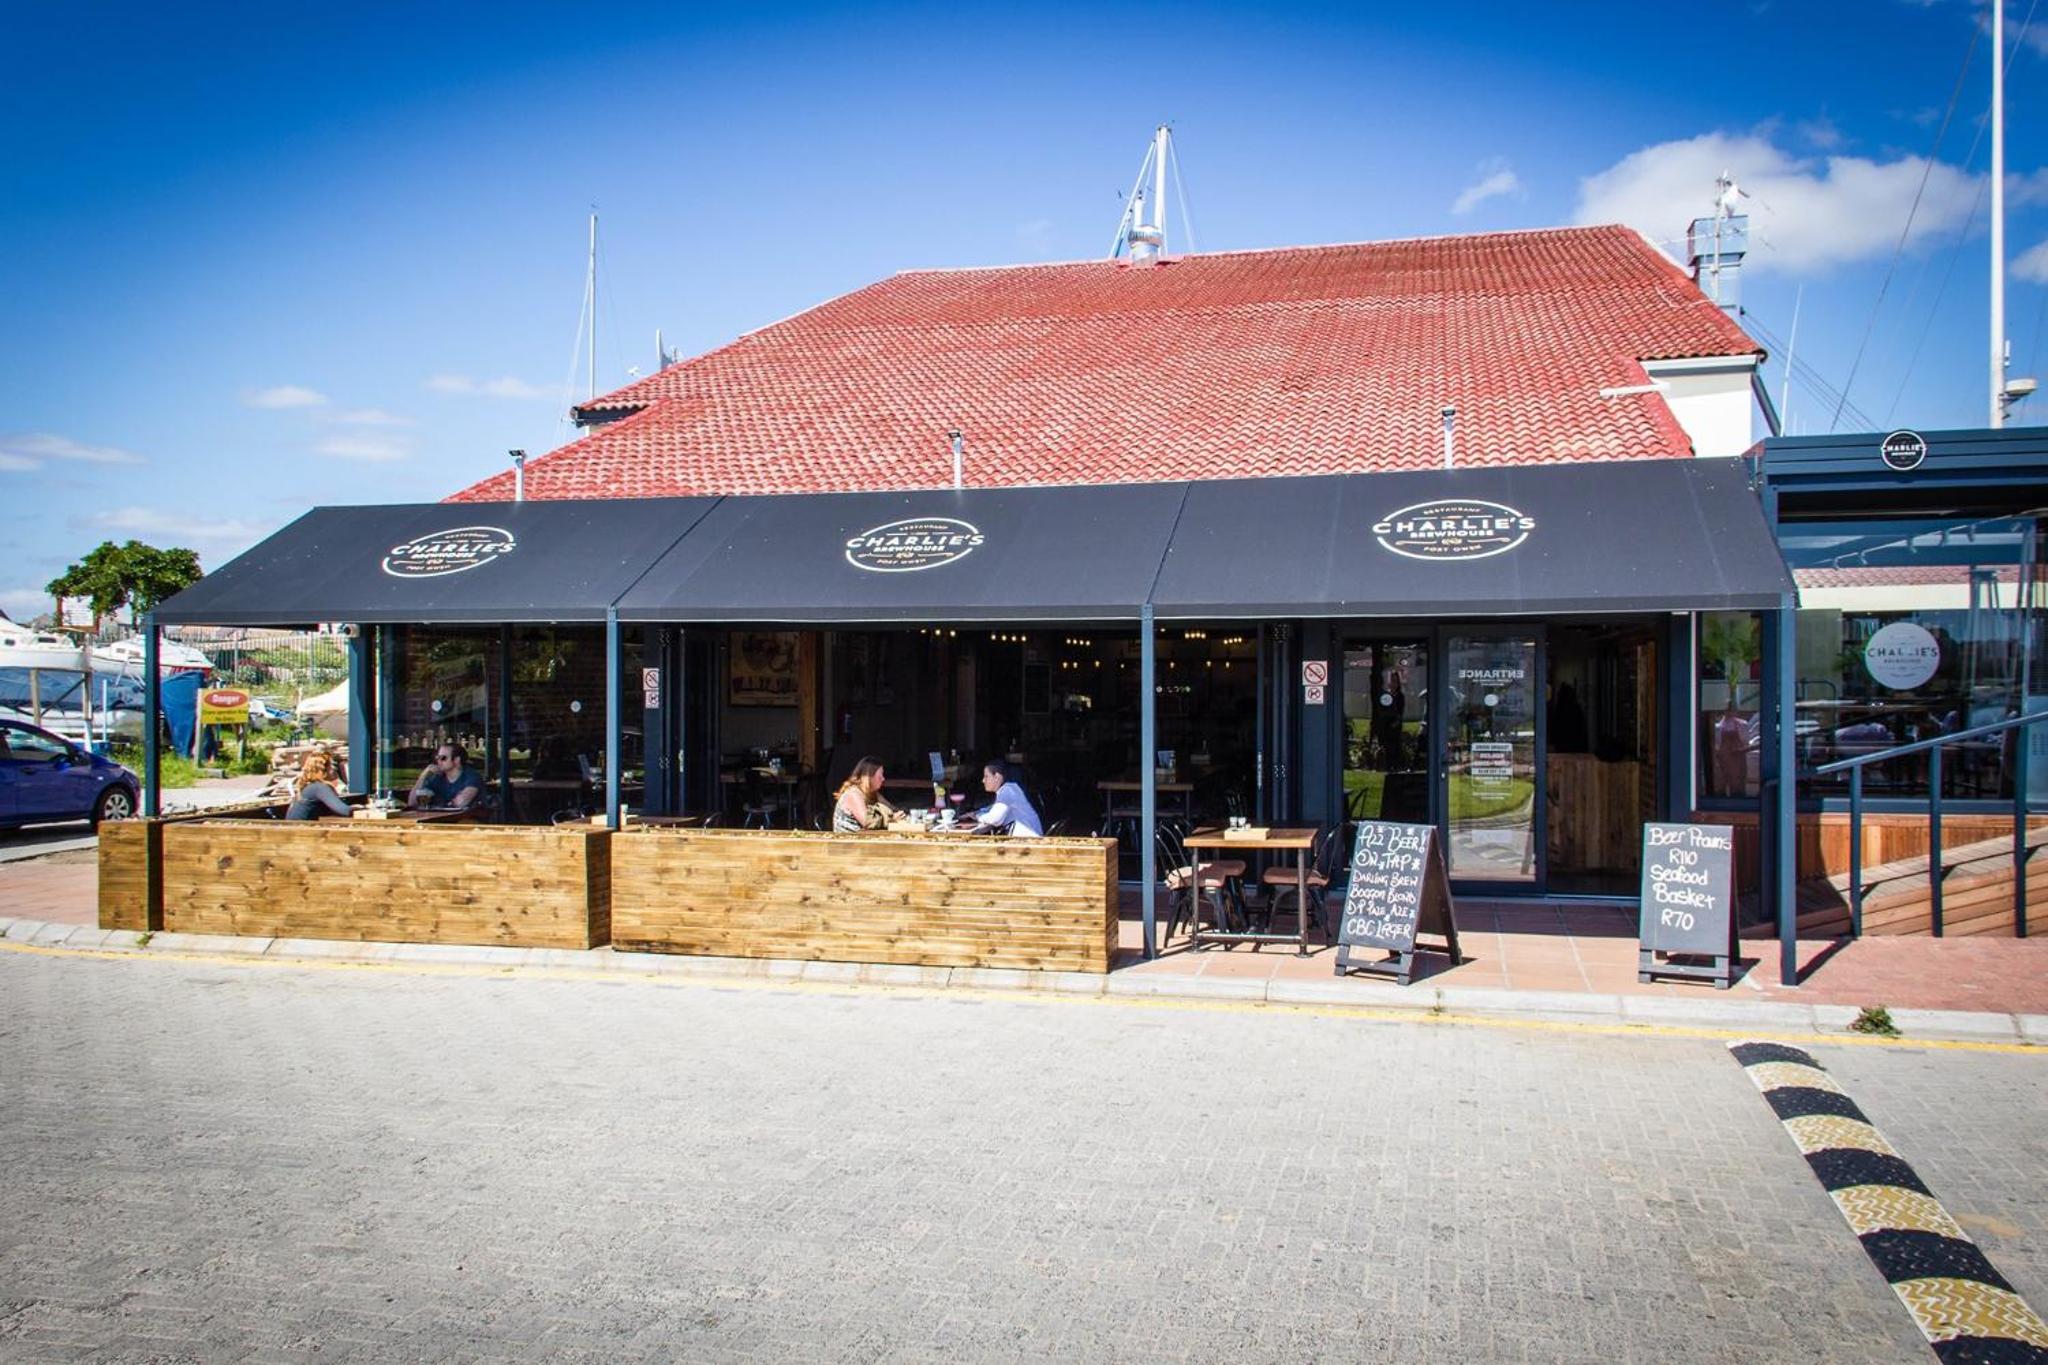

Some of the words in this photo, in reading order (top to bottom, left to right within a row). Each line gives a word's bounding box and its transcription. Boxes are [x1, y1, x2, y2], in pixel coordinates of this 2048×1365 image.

[1372, 517, 1536, 534] CHARLIE'S
[1410, 530, 1494, 538] BREWHOUSE
[391, 542, 517, 555] CHARLIE'S
[846, 534, 985, 548] CHARLIE'S
[872, 545, 946, 553] BREWHOUSE
[1687, 827, 1732, 850] Prawns
[1382, 852, 1412, 871] TAP
[1669, 848, 1698, 866] R110
[1650, 864, 1708, 886] Seafood
[1652, 882, 1716, 910] Basket
[1346, 919, 1375, 936] CBC
[1661, 908, 1694, 931] R70
